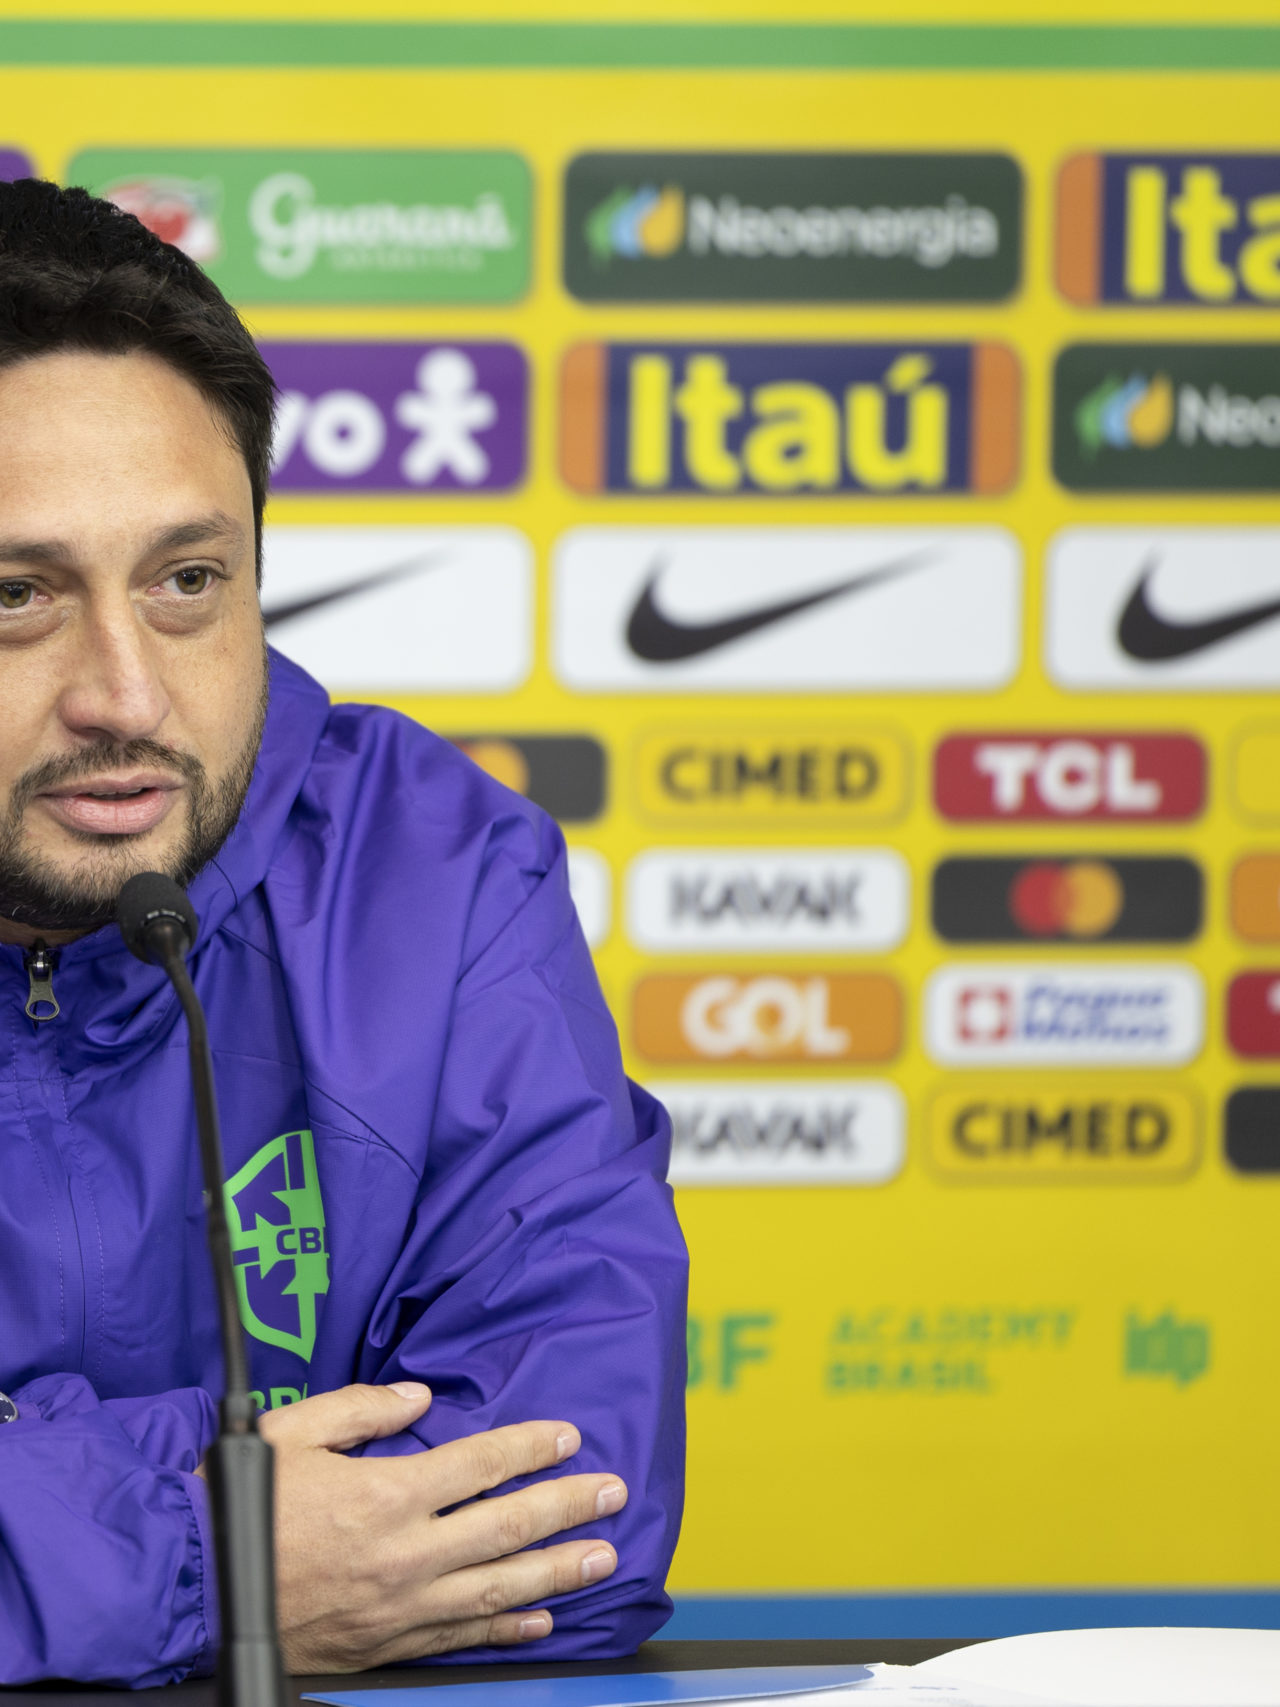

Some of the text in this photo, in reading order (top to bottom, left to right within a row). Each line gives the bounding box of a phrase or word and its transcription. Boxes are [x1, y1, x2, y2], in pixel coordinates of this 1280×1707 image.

[688, 196, 998, 266] Neoenergia
[631, 355, 949, 490] Itaú
[661, 748, 880, 802] CIMED
[976, 743, 1159, 811] TCL
[681, 977, 848, 1057] GOL
[951, 1103, 1172, 1157] CIMED
